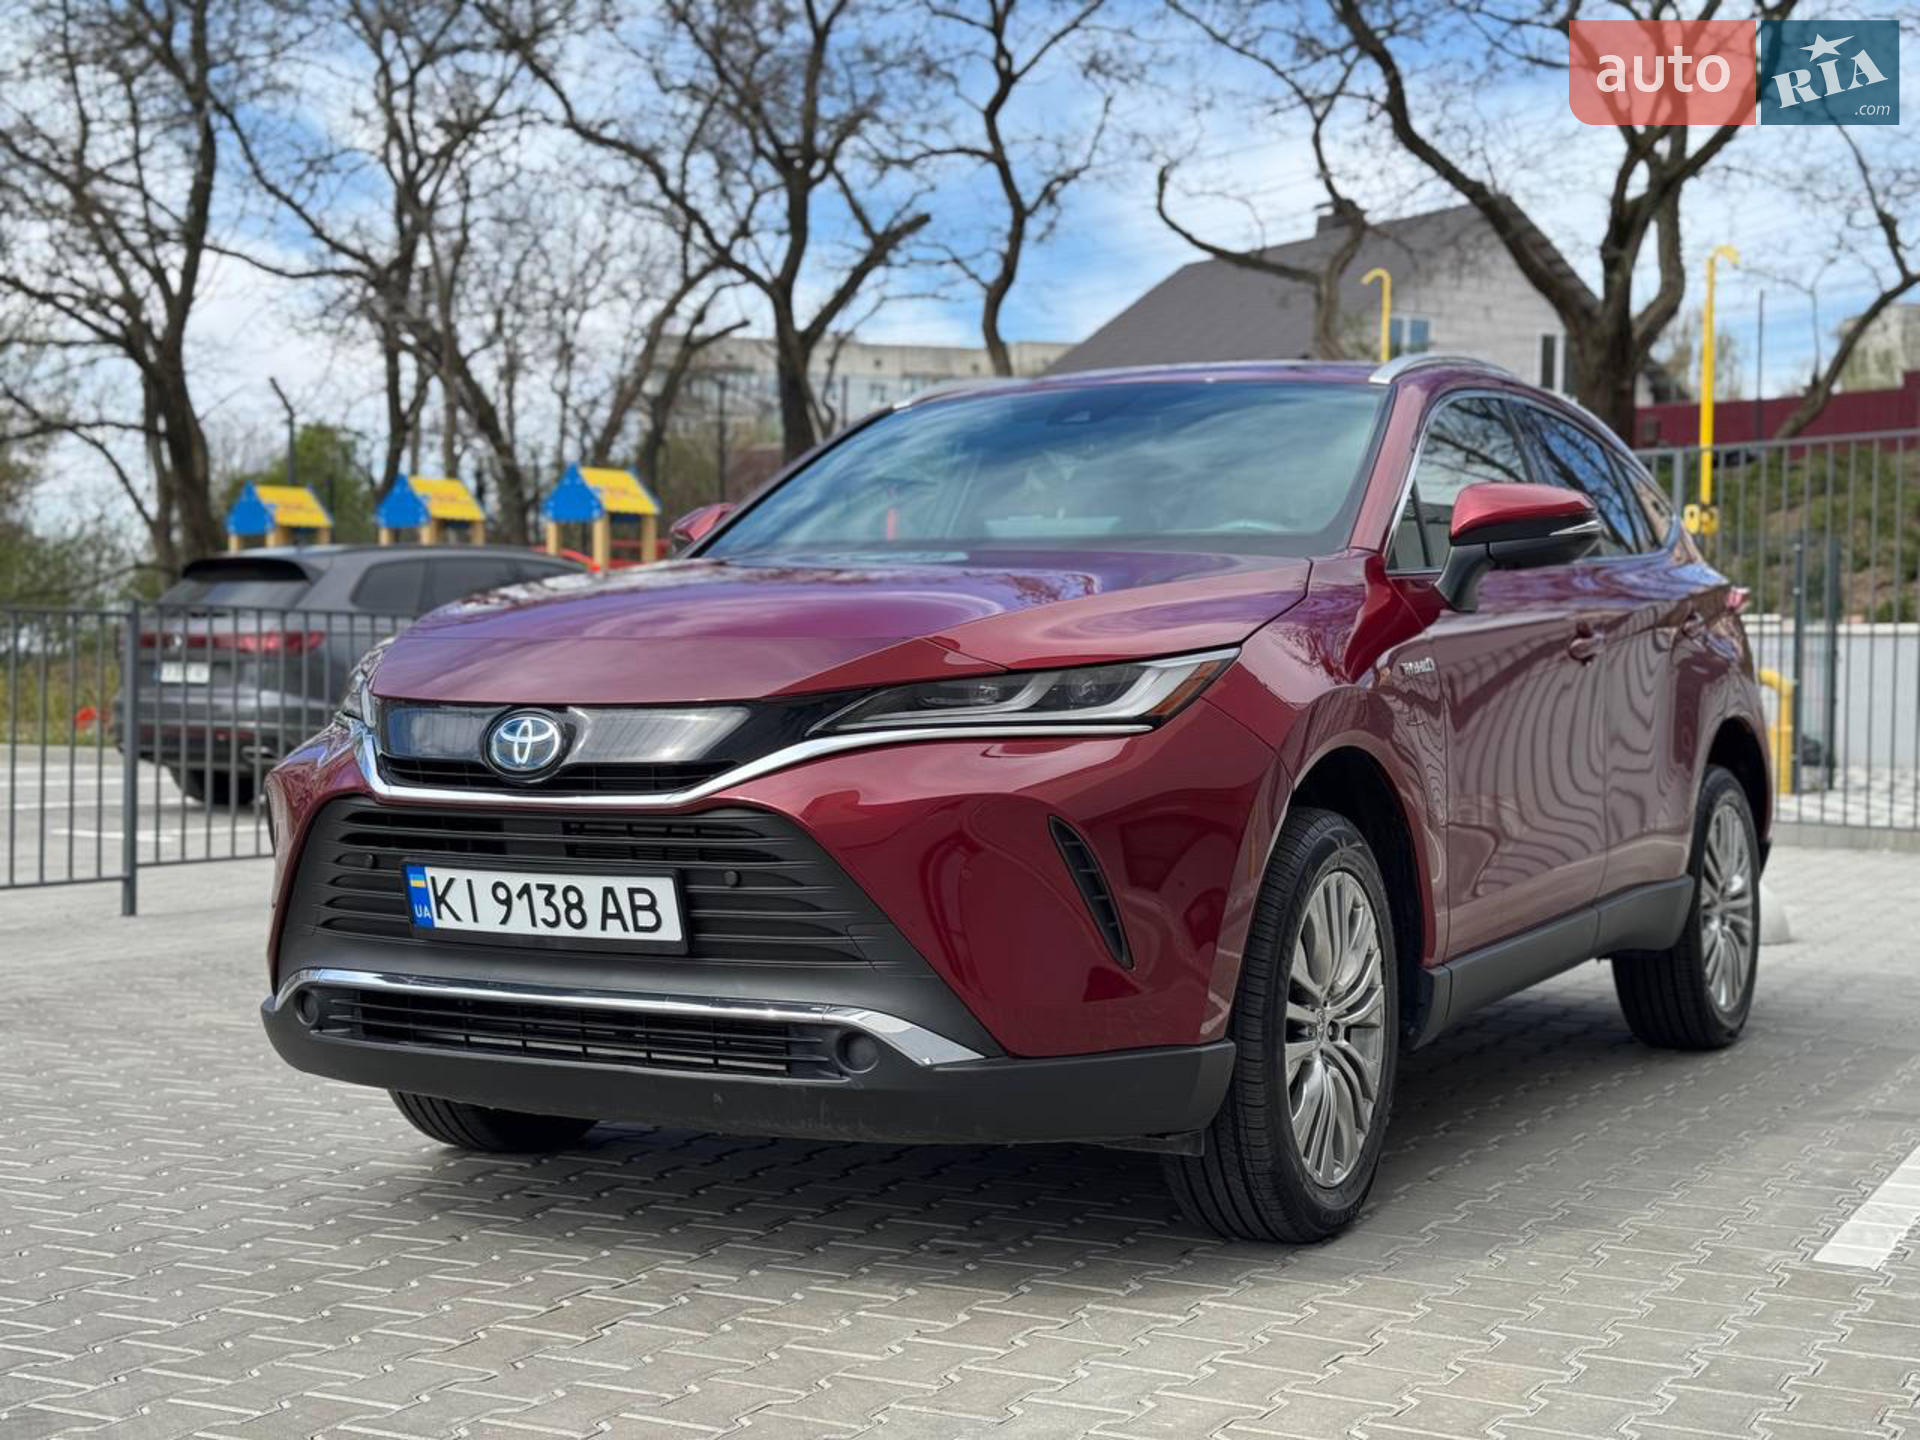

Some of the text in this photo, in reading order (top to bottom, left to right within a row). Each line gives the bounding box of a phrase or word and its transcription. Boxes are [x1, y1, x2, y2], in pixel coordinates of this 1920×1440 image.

[414, 903, 432, 919] UA
[430, 875, 662, 933] KI 9138 AB
